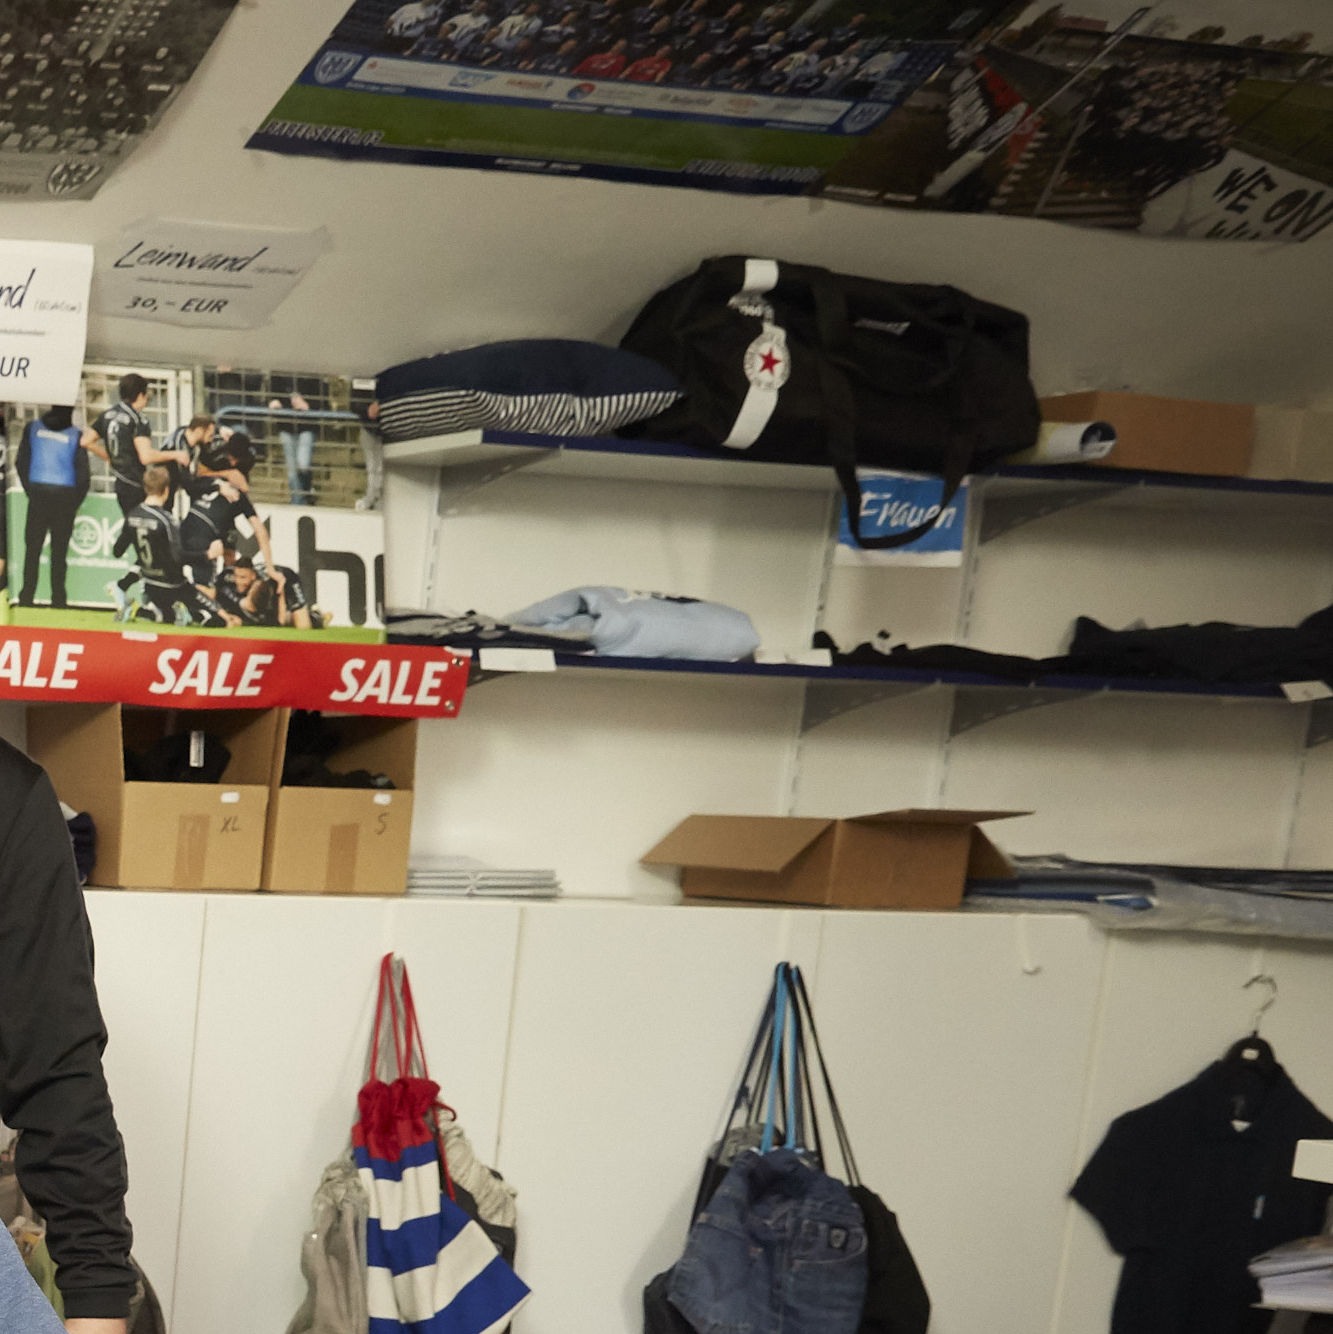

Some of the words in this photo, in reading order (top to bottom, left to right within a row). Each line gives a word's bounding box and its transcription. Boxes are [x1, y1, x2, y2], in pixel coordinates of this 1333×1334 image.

[1213, 165, 1279, 214] WE
[113, 240, 270, 272] Leinwand
[179, 297, 229, 313] EUR
[859, 490, 958, 529] Frauen
[148, 648, 275, 697] SALE
[329, 657, 449, 706] SALE
